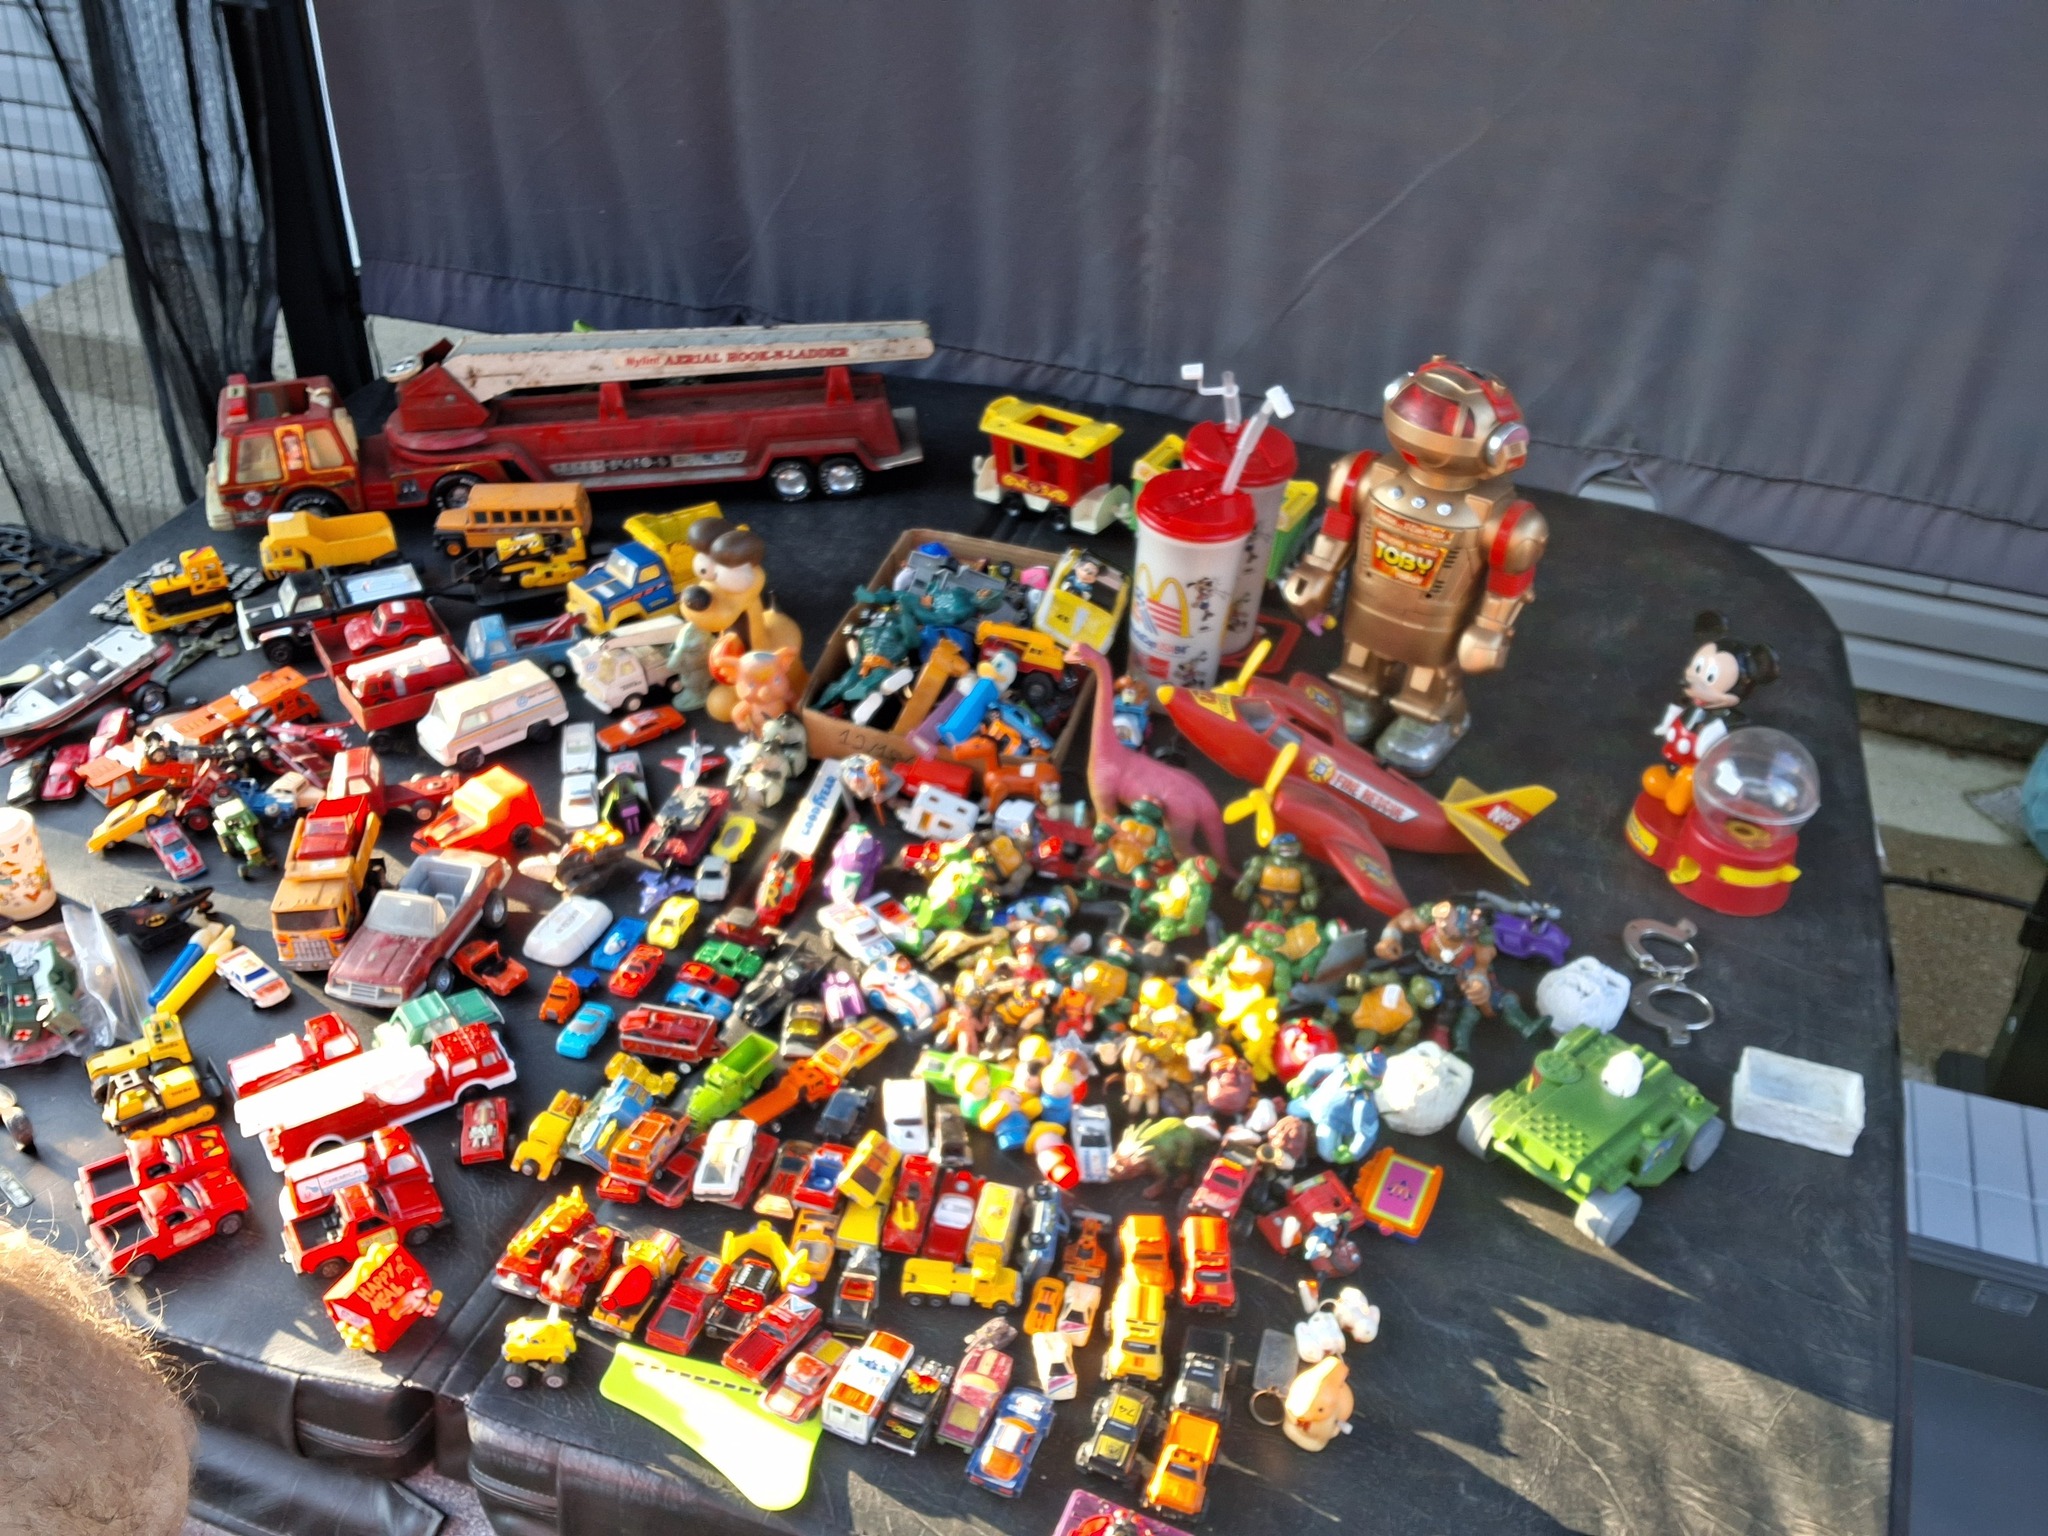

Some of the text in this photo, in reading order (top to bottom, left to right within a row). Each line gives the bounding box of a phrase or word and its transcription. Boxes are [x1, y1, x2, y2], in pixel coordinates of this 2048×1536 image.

[665, 353, 723, 365] AERIAL
[355, 1262, 406, 1315] HAPPY MEAL
